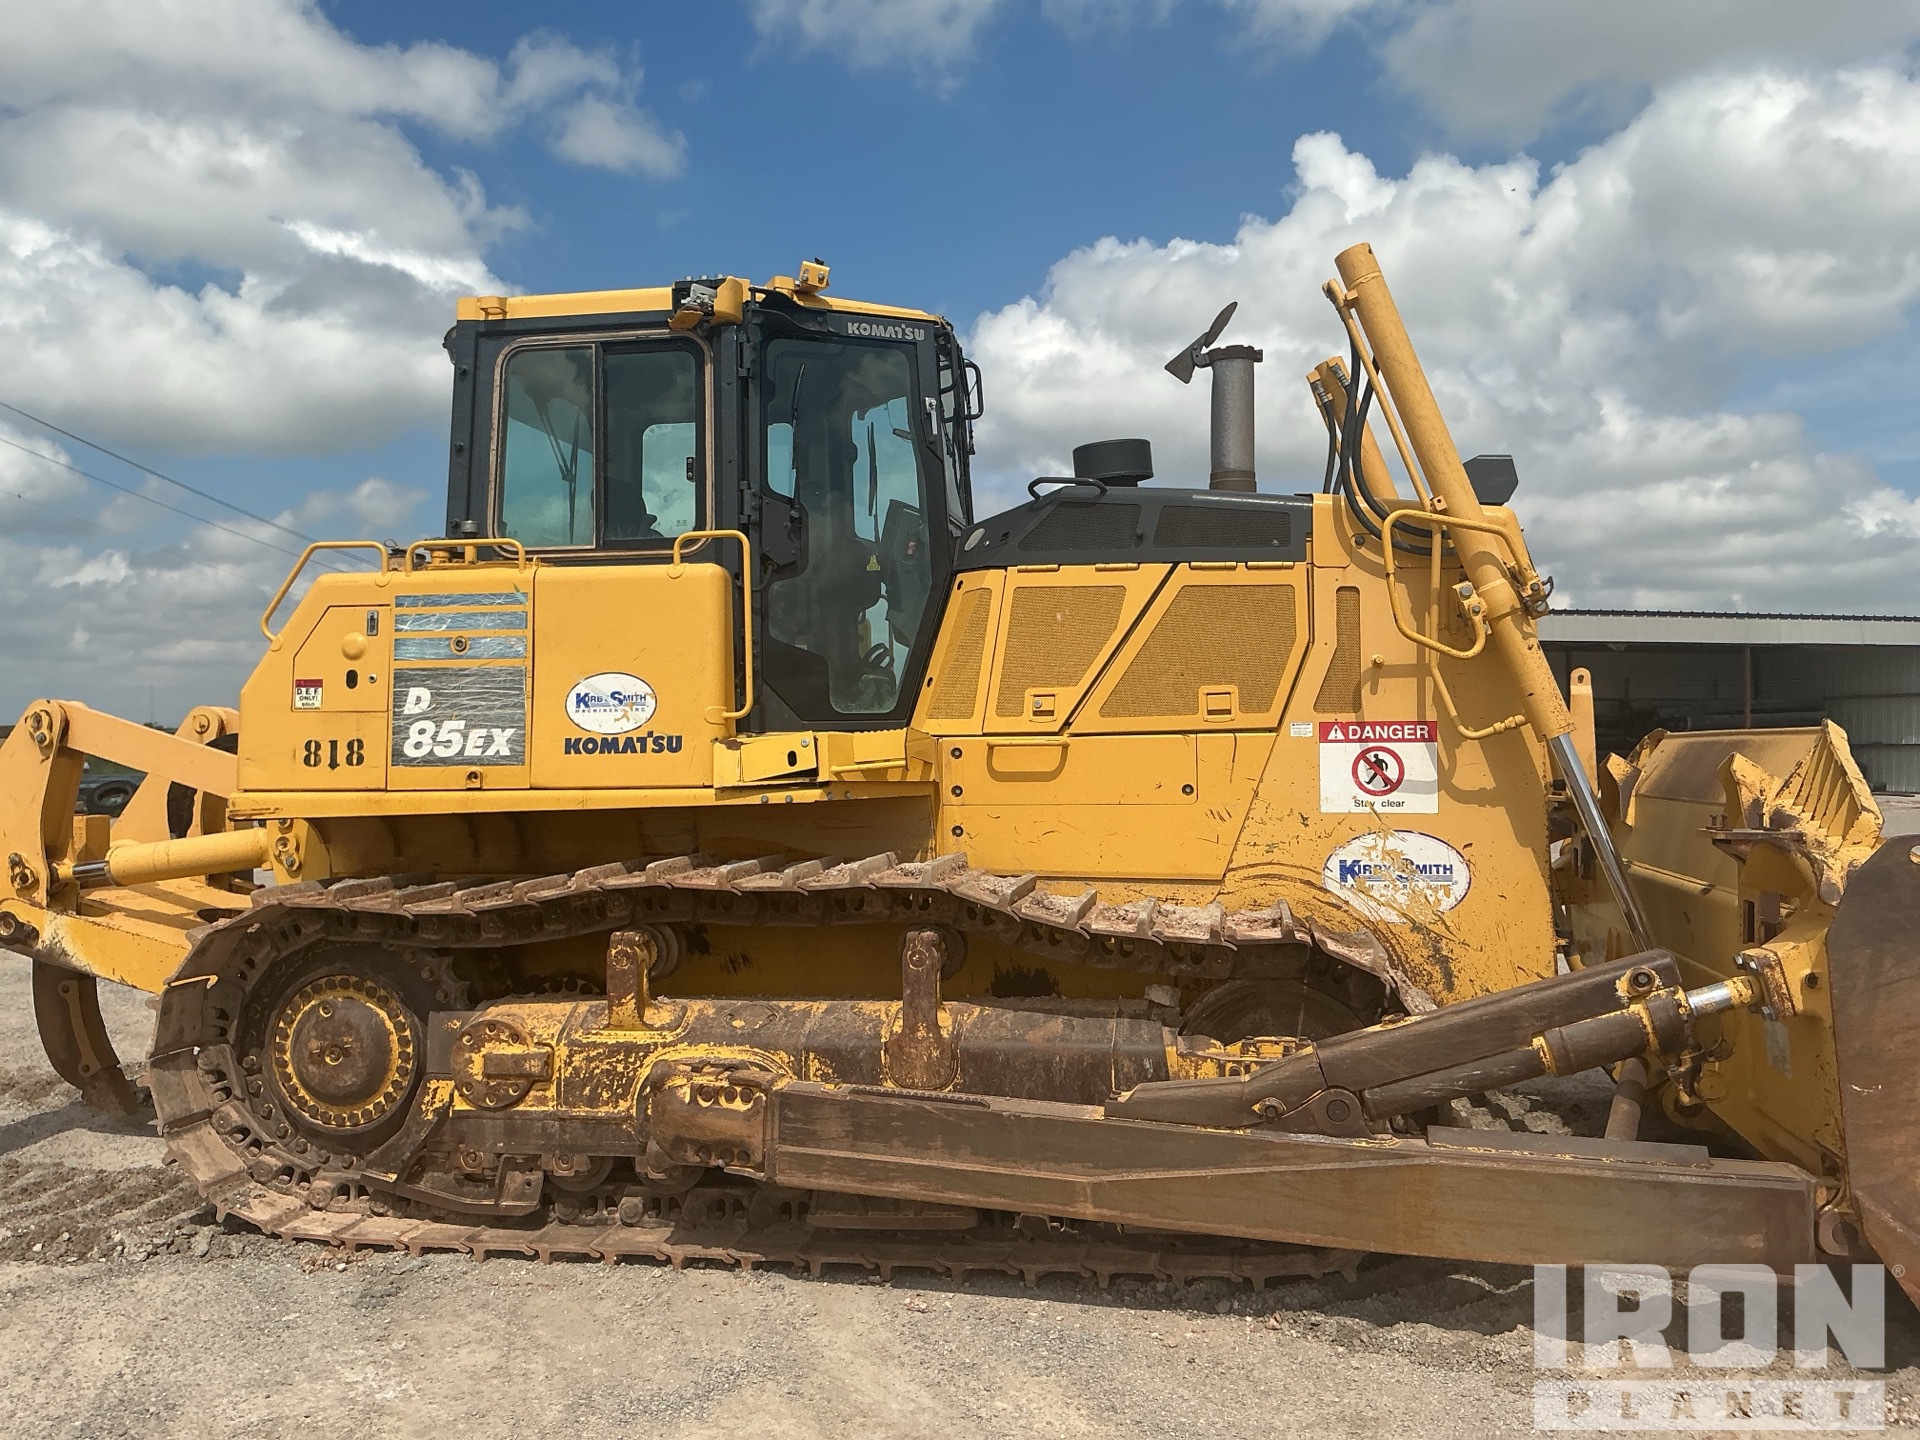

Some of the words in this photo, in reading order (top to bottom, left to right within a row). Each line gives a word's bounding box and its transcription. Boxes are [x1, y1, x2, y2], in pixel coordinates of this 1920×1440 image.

[847, 322, 925, 341] KOMATSU
[404, 687, 432, 714] D
[403, 720, 517, 758] 85EX
[564, 731, 683, 754] KOMATSU
[1348, 725, 1429, 739] DANGER
[303, 738, 365, 770] 818
[1354, 799, 1375, 809] Stay
[1381, 799, 1405, 807] clear
